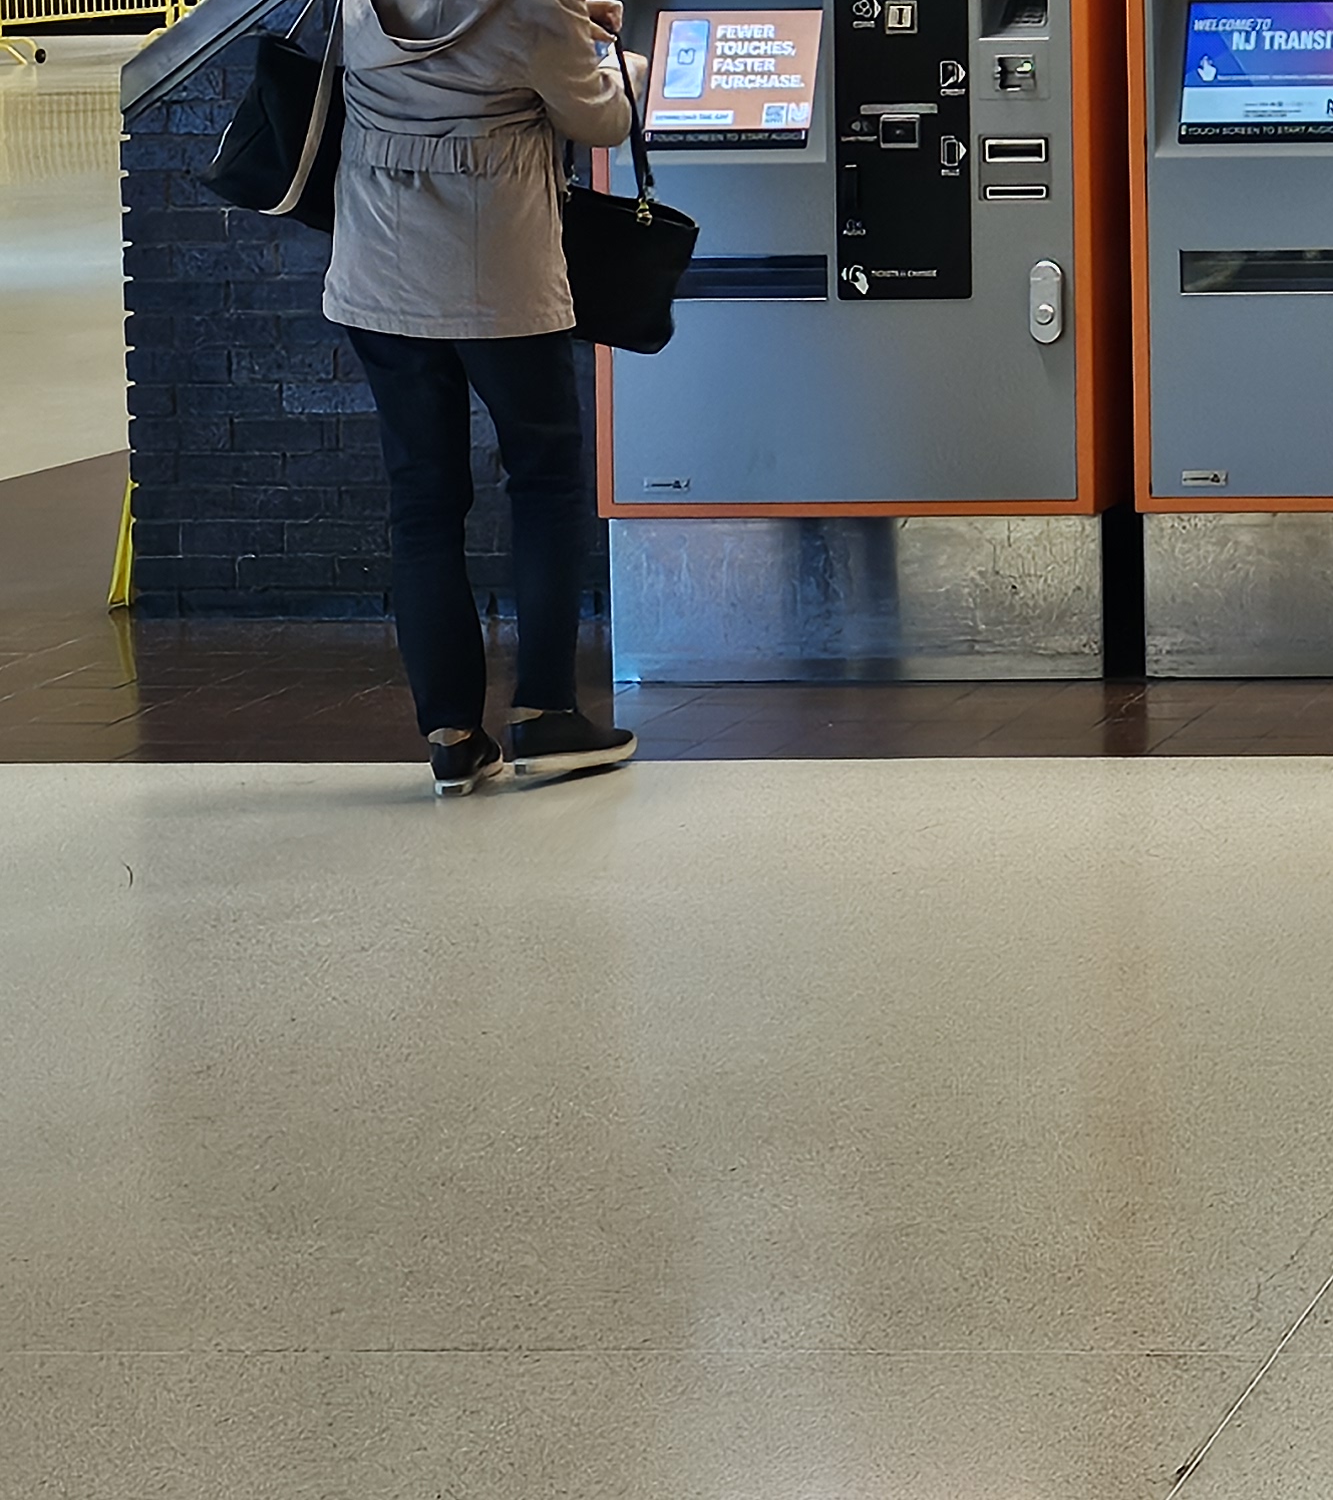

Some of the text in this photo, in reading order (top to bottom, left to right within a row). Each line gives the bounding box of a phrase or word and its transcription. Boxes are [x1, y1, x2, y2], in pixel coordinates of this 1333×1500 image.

[716, 24, 775, 39] FEWER
[1194, 18, 1272, 32] WELCOME TO
[1232, 31, 1257, 50] NJ
[714, 41, 796, 56] TOUCHES,
[712, 58, 775, 73] FASTER
[710, 75, 805, 90] PURCHASE.
